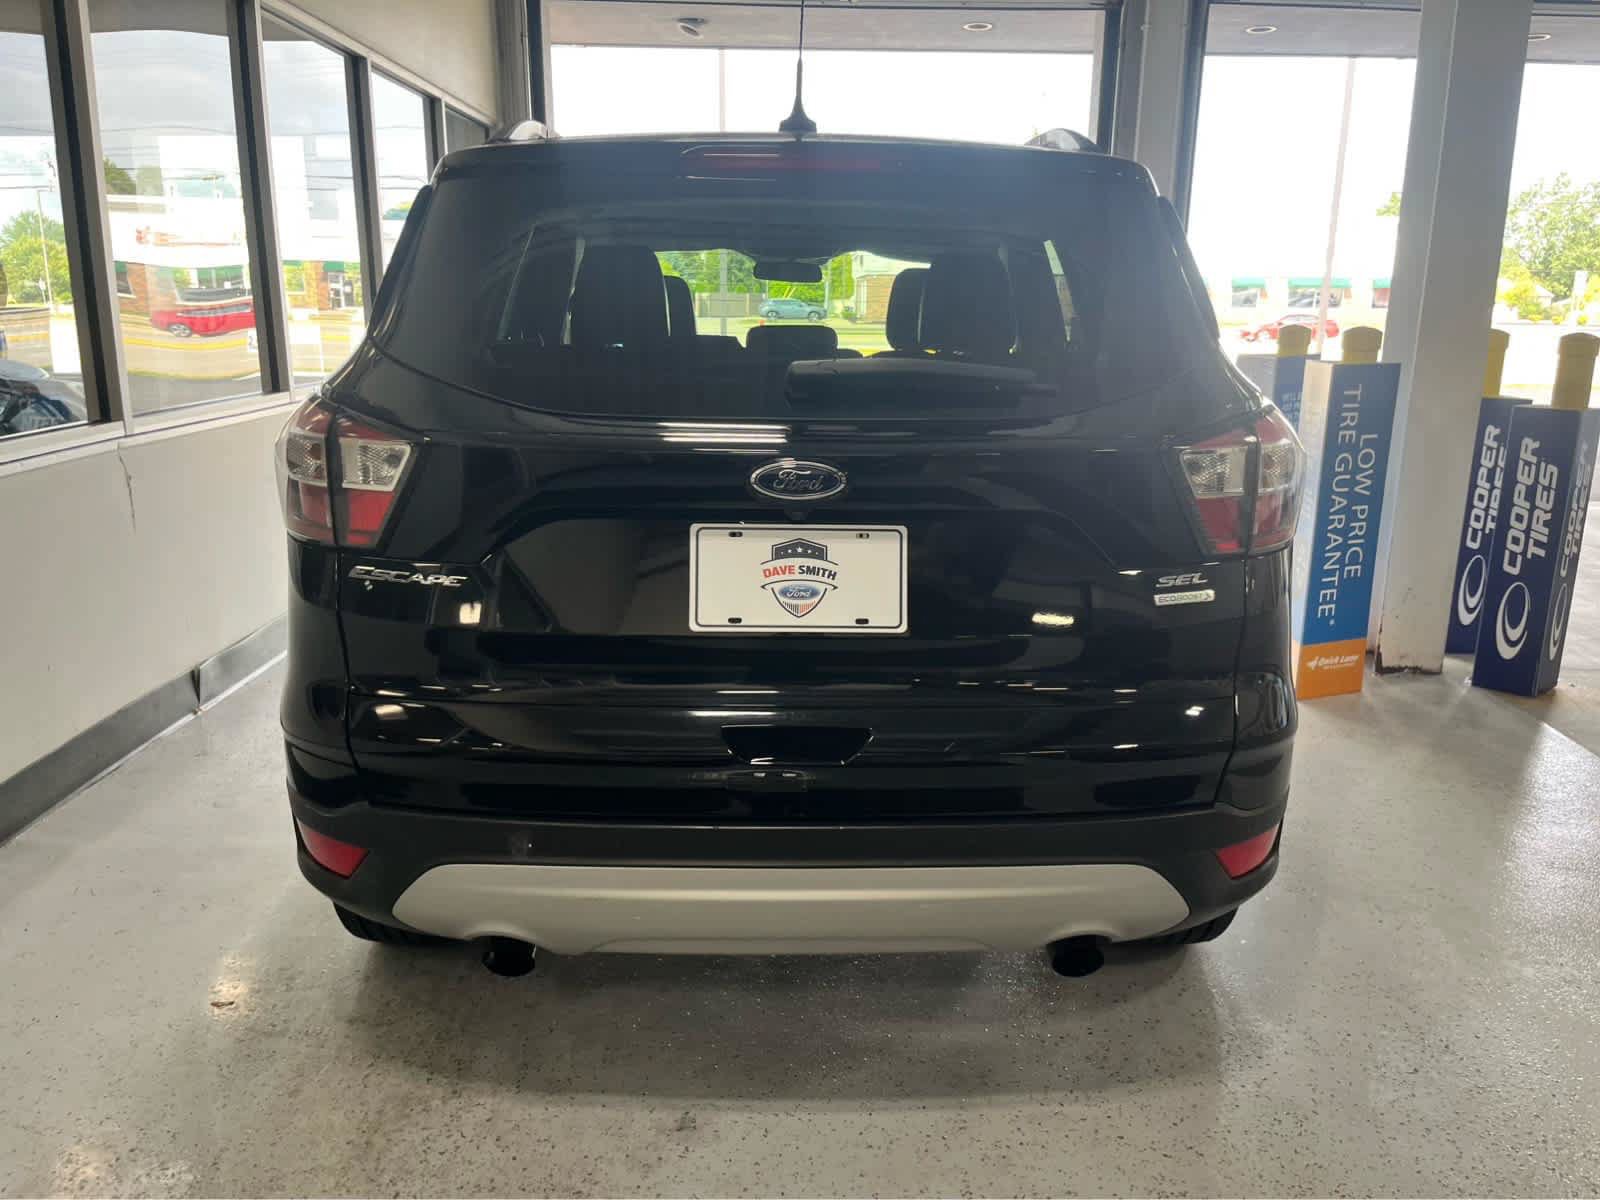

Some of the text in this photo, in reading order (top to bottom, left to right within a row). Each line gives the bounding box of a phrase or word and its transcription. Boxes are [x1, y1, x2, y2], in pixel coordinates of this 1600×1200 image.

[1338, 383, 1363, 444] TIRE
[773, 469, 824, 490] Ford
[1465, 424, 1501, 550] COOPER
[1343, 433, 1378, 580] LOW PRICE
[1502, 436, 1541, 576] COOPER
[1526, 460, 1559, 560] TIRES
[348, 565, 469, 588] ESCAPE
[763, 565, 837, 581] DAVE SMITH
[786, 587, 812, 598] Ford
[1156, 572, 1208, 588] SEL
